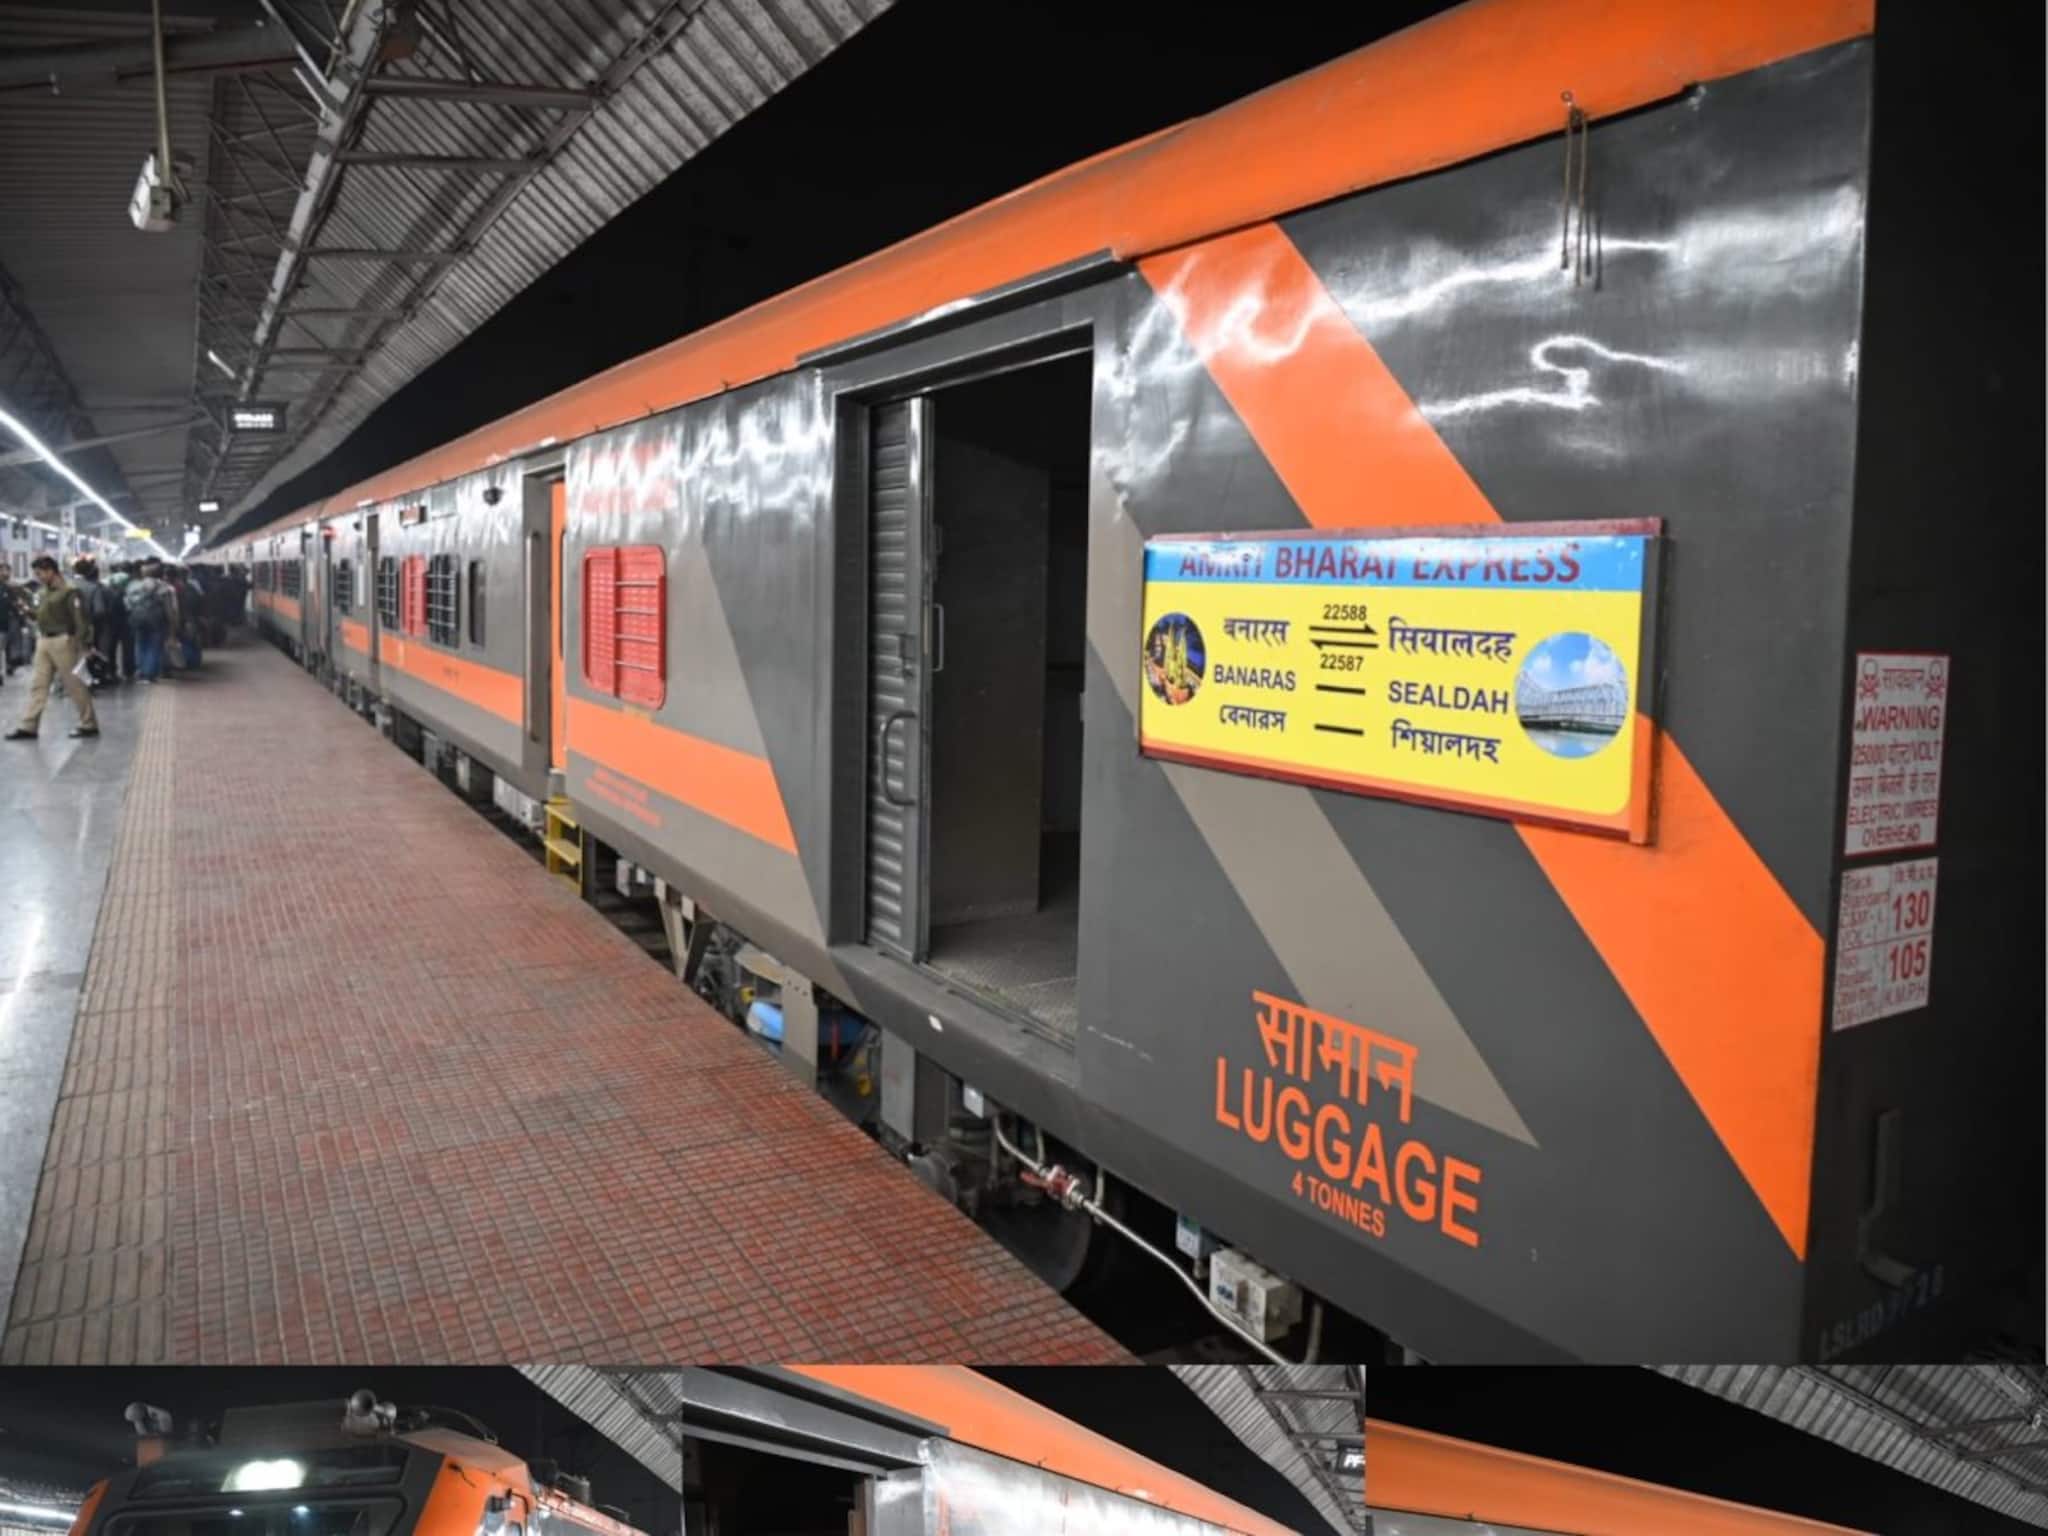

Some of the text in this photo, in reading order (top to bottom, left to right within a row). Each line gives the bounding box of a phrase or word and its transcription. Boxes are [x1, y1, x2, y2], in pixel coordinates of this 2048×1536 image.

[1322, 603, 1368, 621] 22588
[1223, 615, 1517, 663] बनारस सियालदह
[1319, 653, 1364, 672] 22587
[1213, 664, 1509, 715] BANARAS SEALDAH
[1219, 704, 1287, 732] বেনারস
[1861, 705, 1940, 732] WARNING
[1893, 889, 1930, 932] 130
[1889, 938, 1926, 982] 105
[1252, 989, 1420, 1125] सामान
[1215, 1055, 1483, 1249] LUGGAGE
[1291, 1170, 1387, 1239] 4 TONNES
